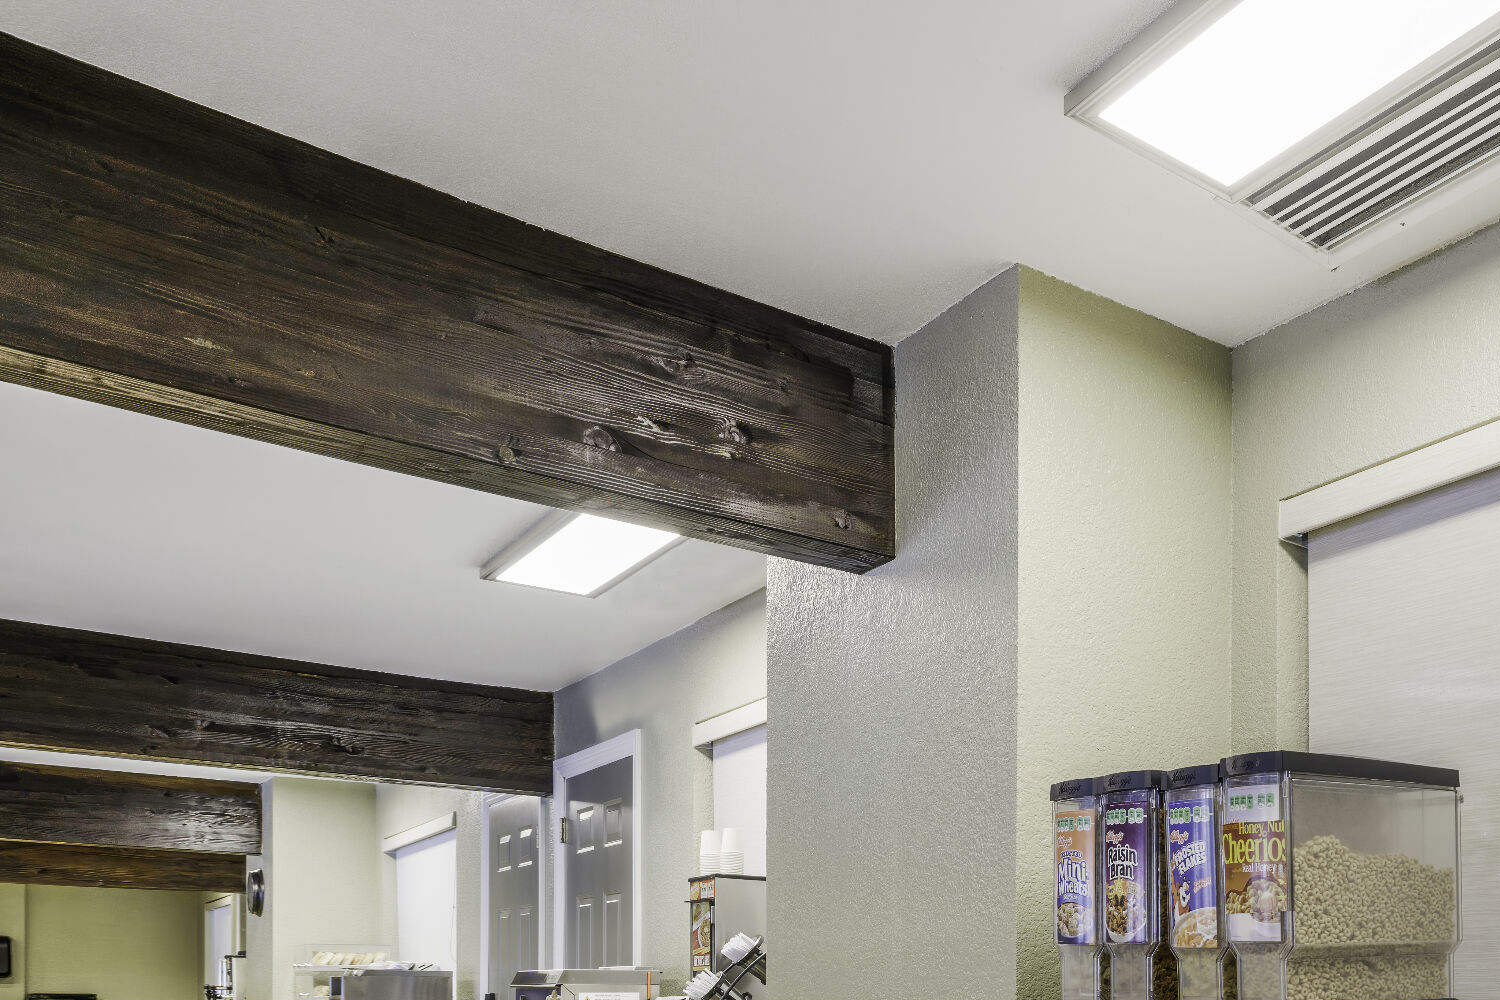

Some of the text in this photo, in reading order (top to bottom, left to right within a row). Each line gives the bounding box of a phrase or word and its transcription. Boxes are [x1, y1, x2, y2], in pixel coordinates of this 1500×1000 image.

[1238, 821, 1264, 835] Honey
[1107, 844, 1138, 868] Raisin
[1174, 840, 1206, 867] FROSTED
[1222, 832, 1286, 865] Cheerios
[1109, 861, 1135, 881] Bran
[1178, 852, 1206, 877] FLAKES
[1058, 878, 1089, 897] Wheats
